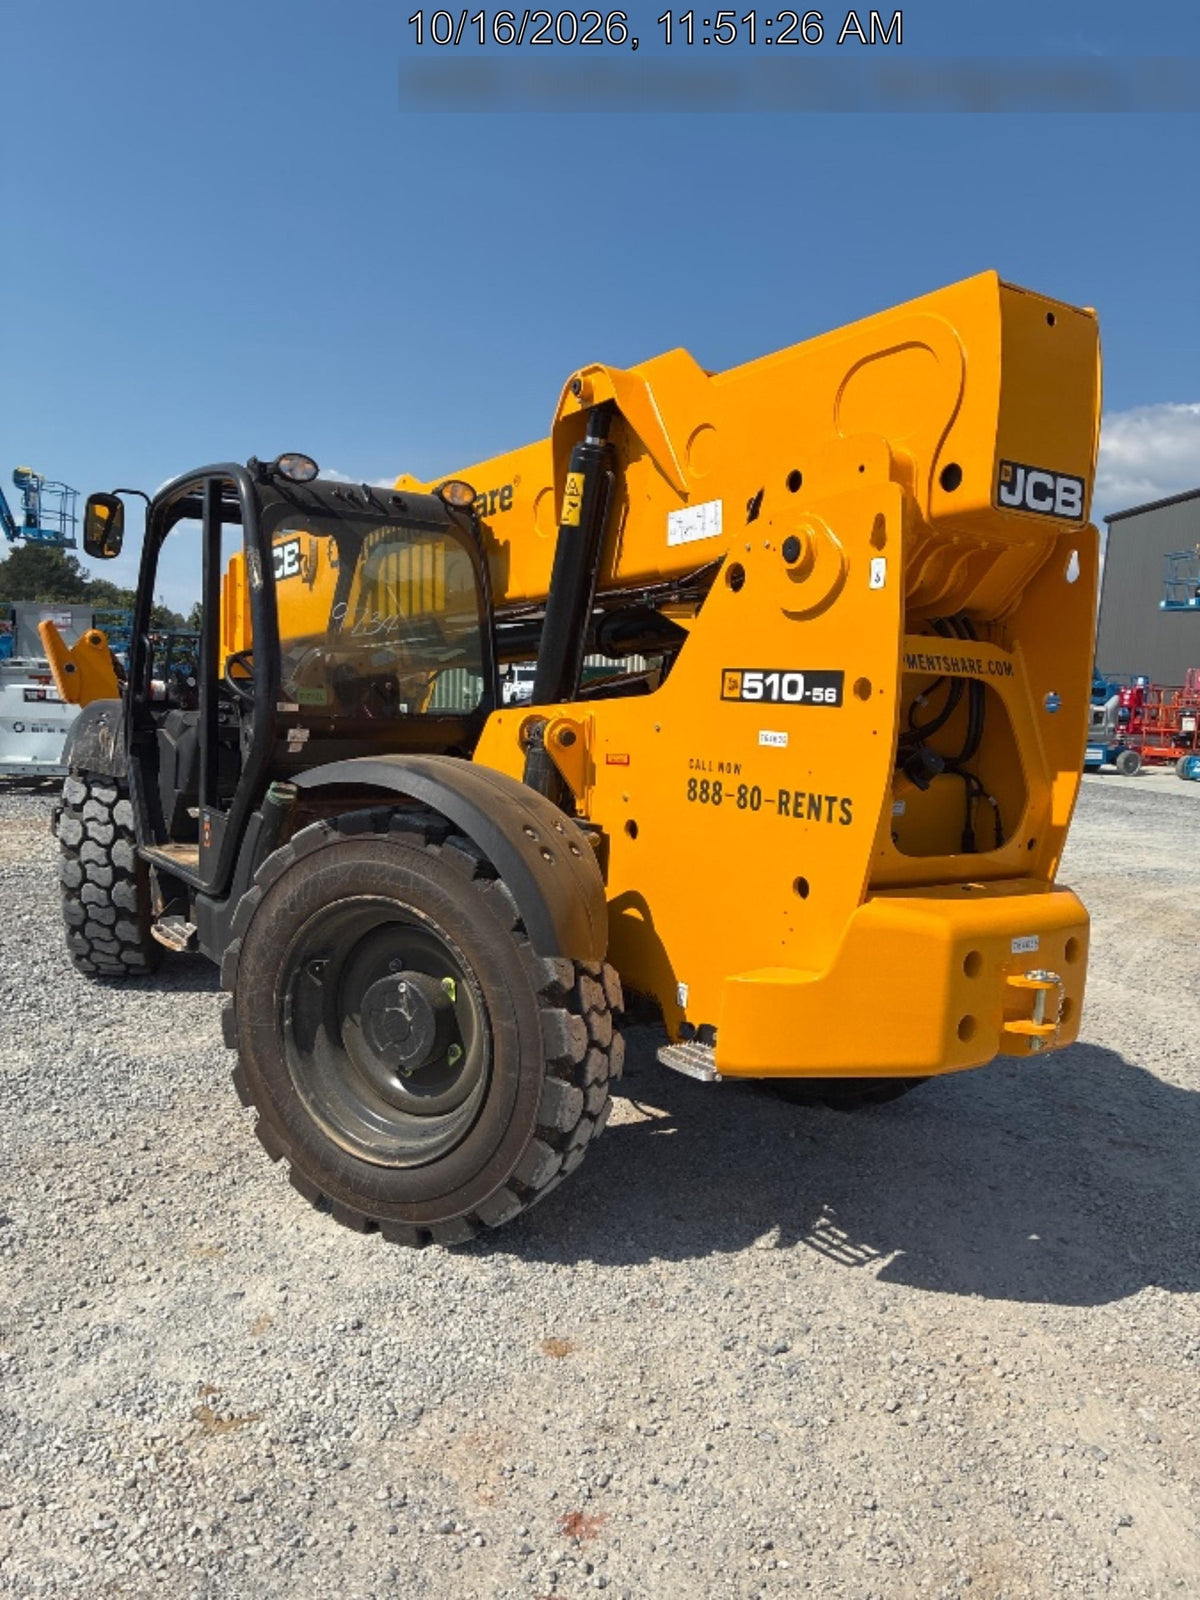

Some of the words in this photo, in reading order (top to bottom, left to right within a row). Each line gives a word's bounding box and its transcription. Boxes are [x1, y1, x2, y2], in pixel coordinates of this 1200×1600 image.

[475, 484, 513, 518] are
[1000, 467, 1083, 517] JCB
[272, 541, 300, 579] CB
[902, 653, 1015, 678] MENTSHARE.COM
[742, 671, 837, 702] 510-56
[689, 758, 713, 772] CALL
[717, 761, 742, 775] NOW
[687, 777, 853, 826] 888-80-RENTS
